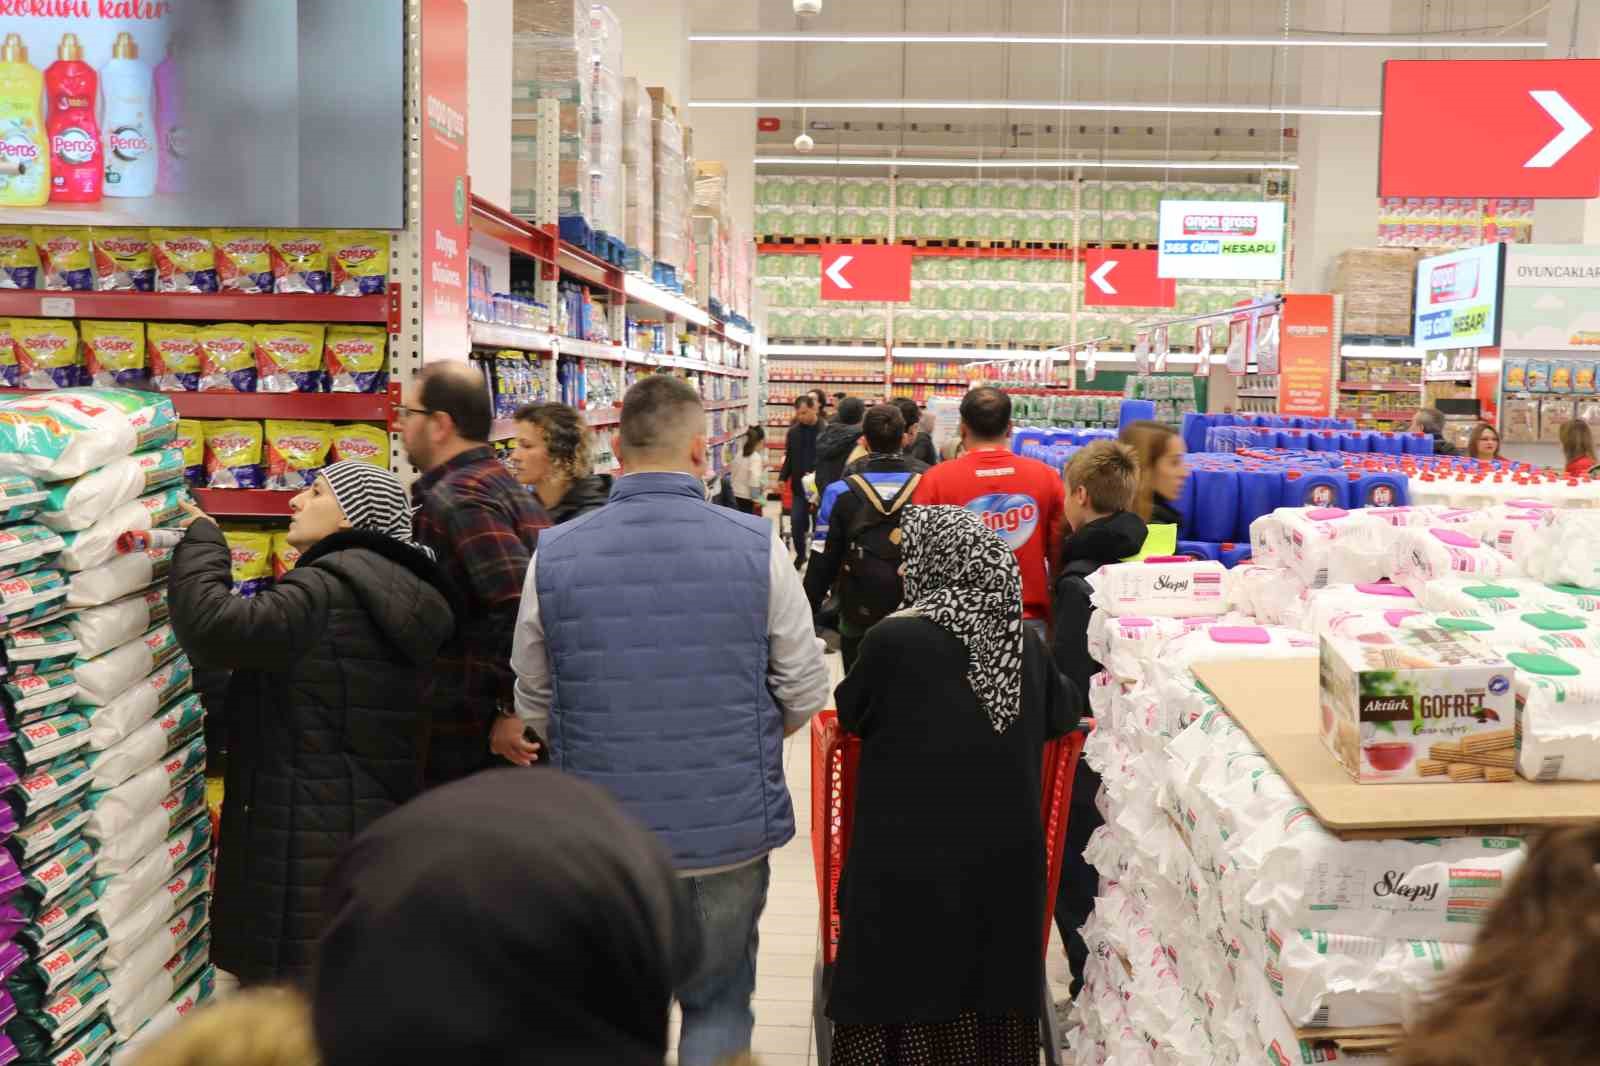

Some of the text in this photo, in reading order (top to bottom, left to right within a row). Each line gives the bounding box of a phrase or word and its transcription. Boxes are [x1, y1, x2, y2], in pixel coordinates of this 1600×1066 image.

[0, 140, 37, 159] Peros
[54, 136, 96, 154] Peros
[110, 135, 147, 151] Peros
[1185, 216, 1256, 231] anpa gross
[103, 240, 149, 252] SPARX
[281, 243, 321, 252] SPARX
[339, 249, 375, 260] SPARX
[1222, 244, 1275, 253] HESAPLI
[335, 343, 374, 354] SPARX
[982, 504, 1034, 532] ingo
[1153, 574, 1189, 592] Sleepy
[1364, 693, 1485, 719] Aktürk GOFRET
[25, 723, 56, 740] Persil
[38, 862, 65, 883] Persil
[1373, 870, 1440, 901] Sleepy
[42, 949, 71, 974] Persil
[47, 996, 78, 1016] Persil
